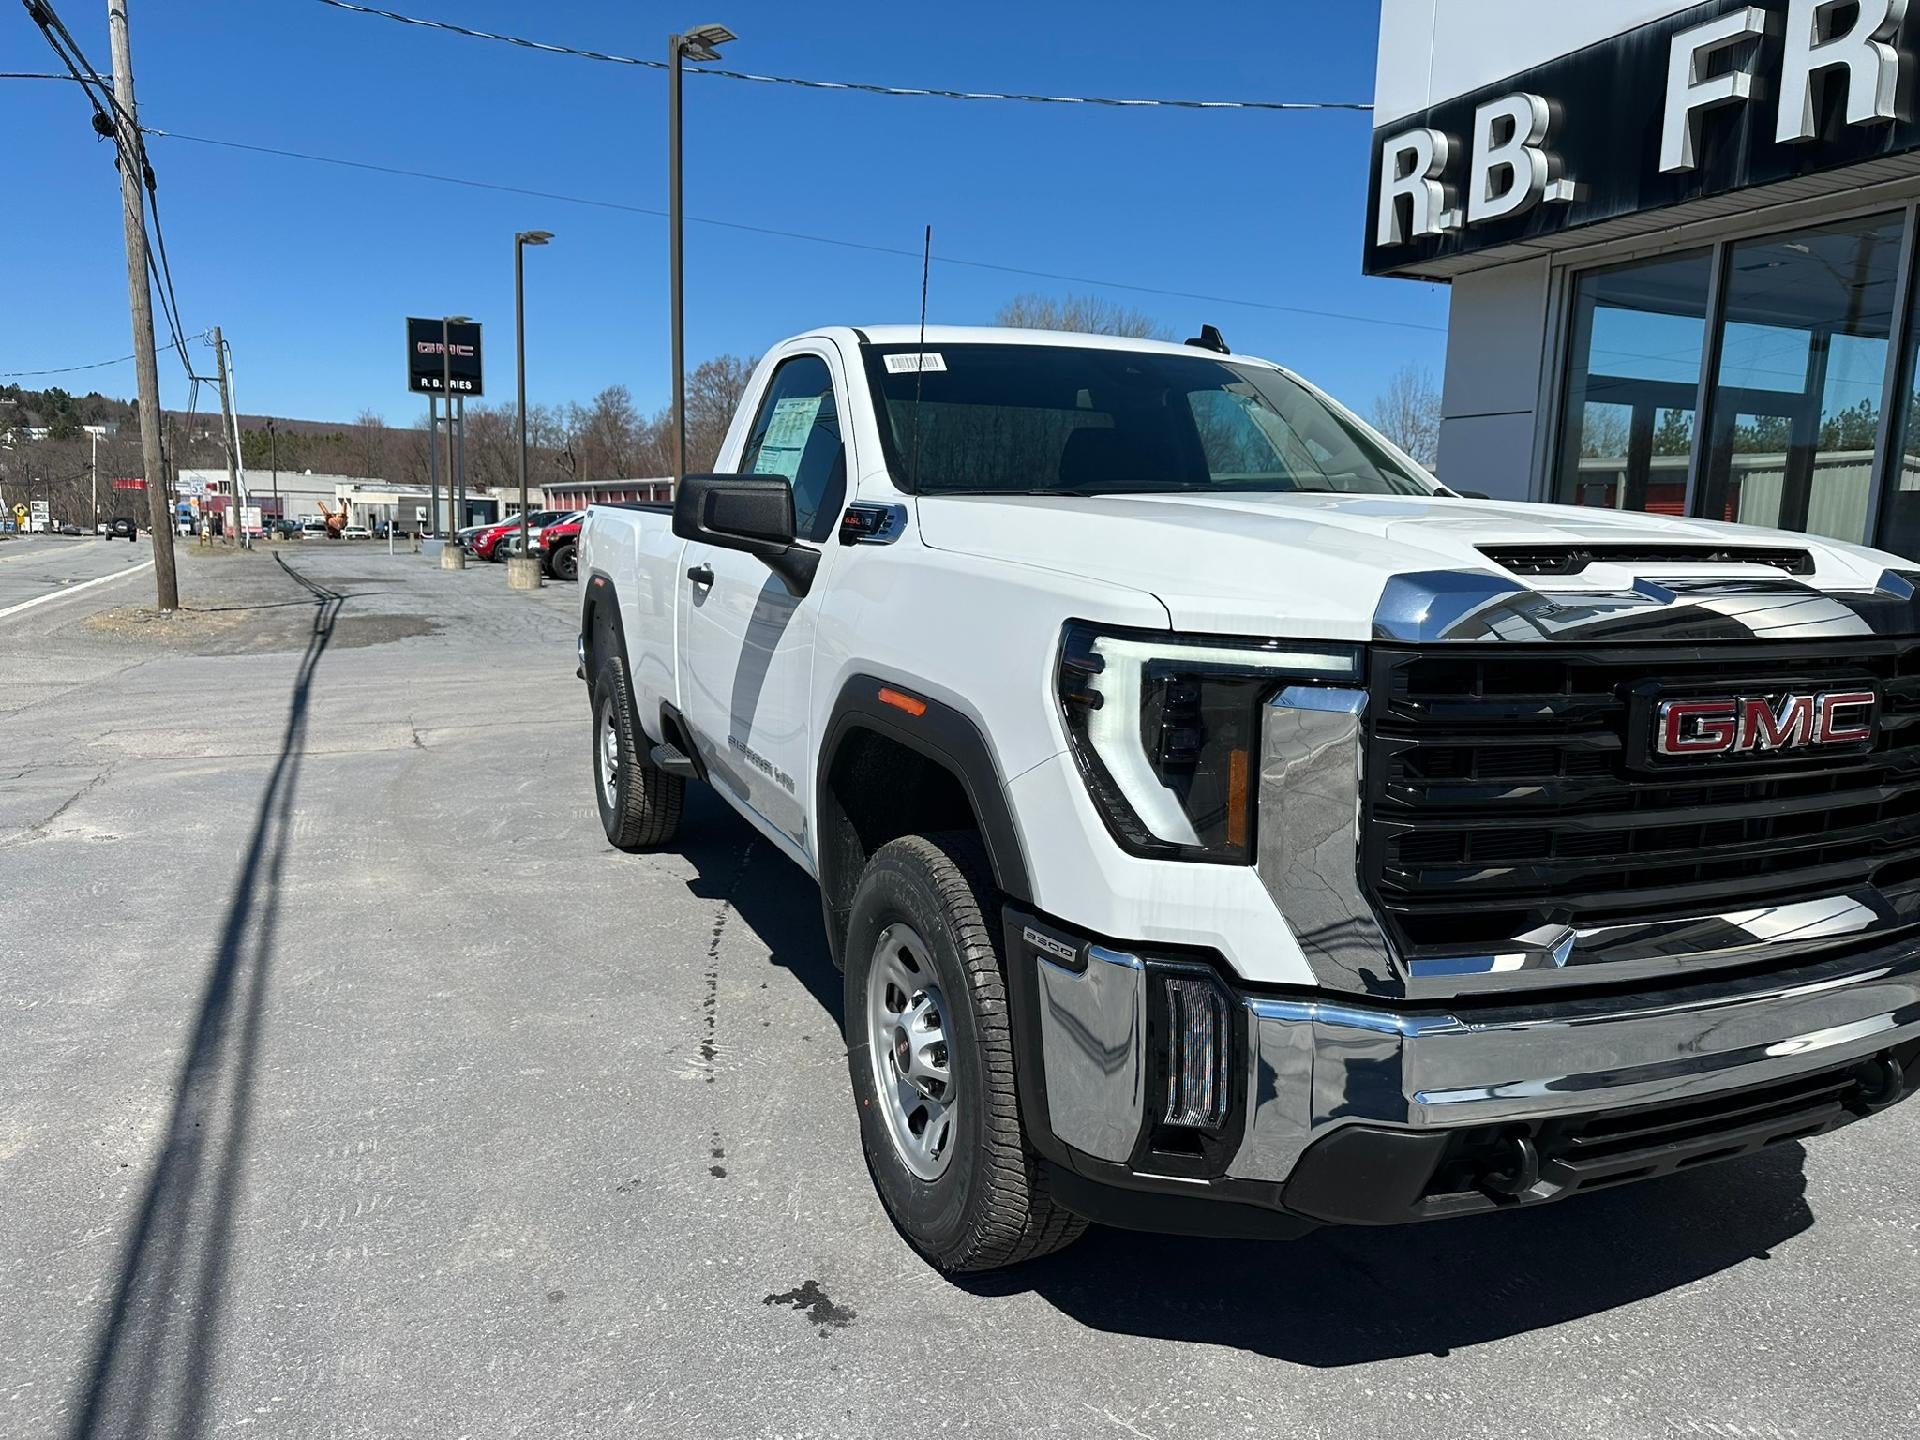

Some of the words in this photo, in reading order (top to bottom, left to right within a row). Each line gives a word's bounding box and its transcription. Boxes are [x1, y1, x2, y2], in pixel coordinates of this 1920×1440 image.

[417, 342, 473, 356] GMC
[446, 380, 472, 389] RIES
[1657, 692, 1875, 756] GMC
